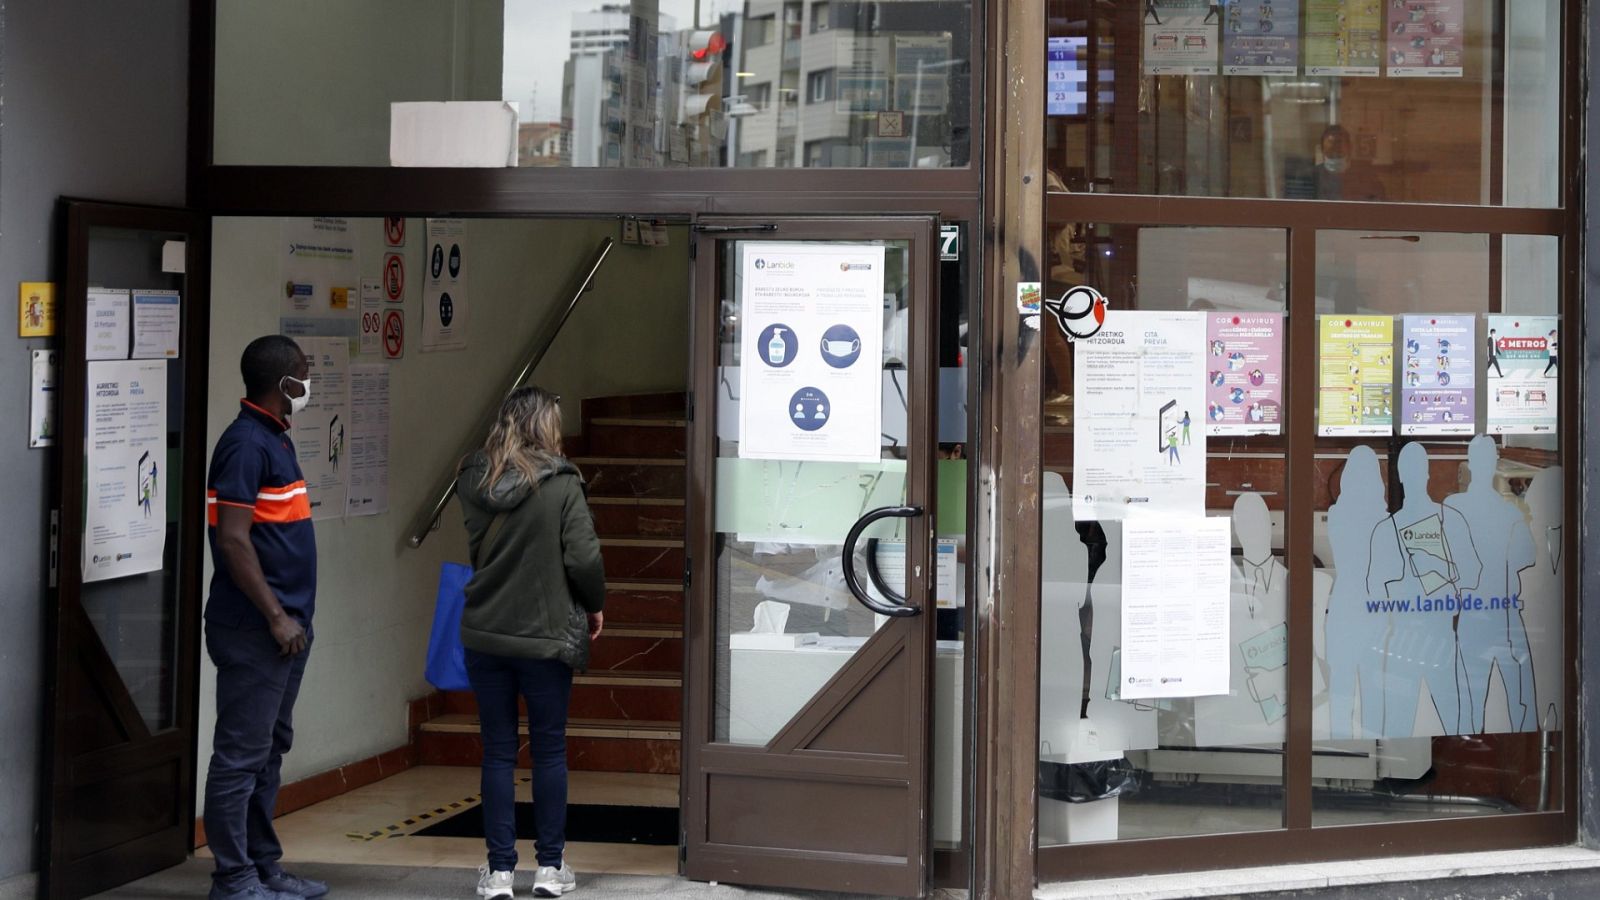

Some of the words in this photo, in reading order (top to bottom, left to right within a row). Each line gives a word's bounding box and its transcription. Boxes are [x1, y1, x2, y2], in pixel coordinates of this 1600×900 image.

[1055, 72, 1065, 80] 13
[1055, 92, 1066, 101] 23
[1500, 340, 1506, 348] 2
[1509, 340, 1546, 348] METROS
[1415, 530, 1441, 540] Lanbide
[1366, 593, 1519, 613] www.lanbide.net
